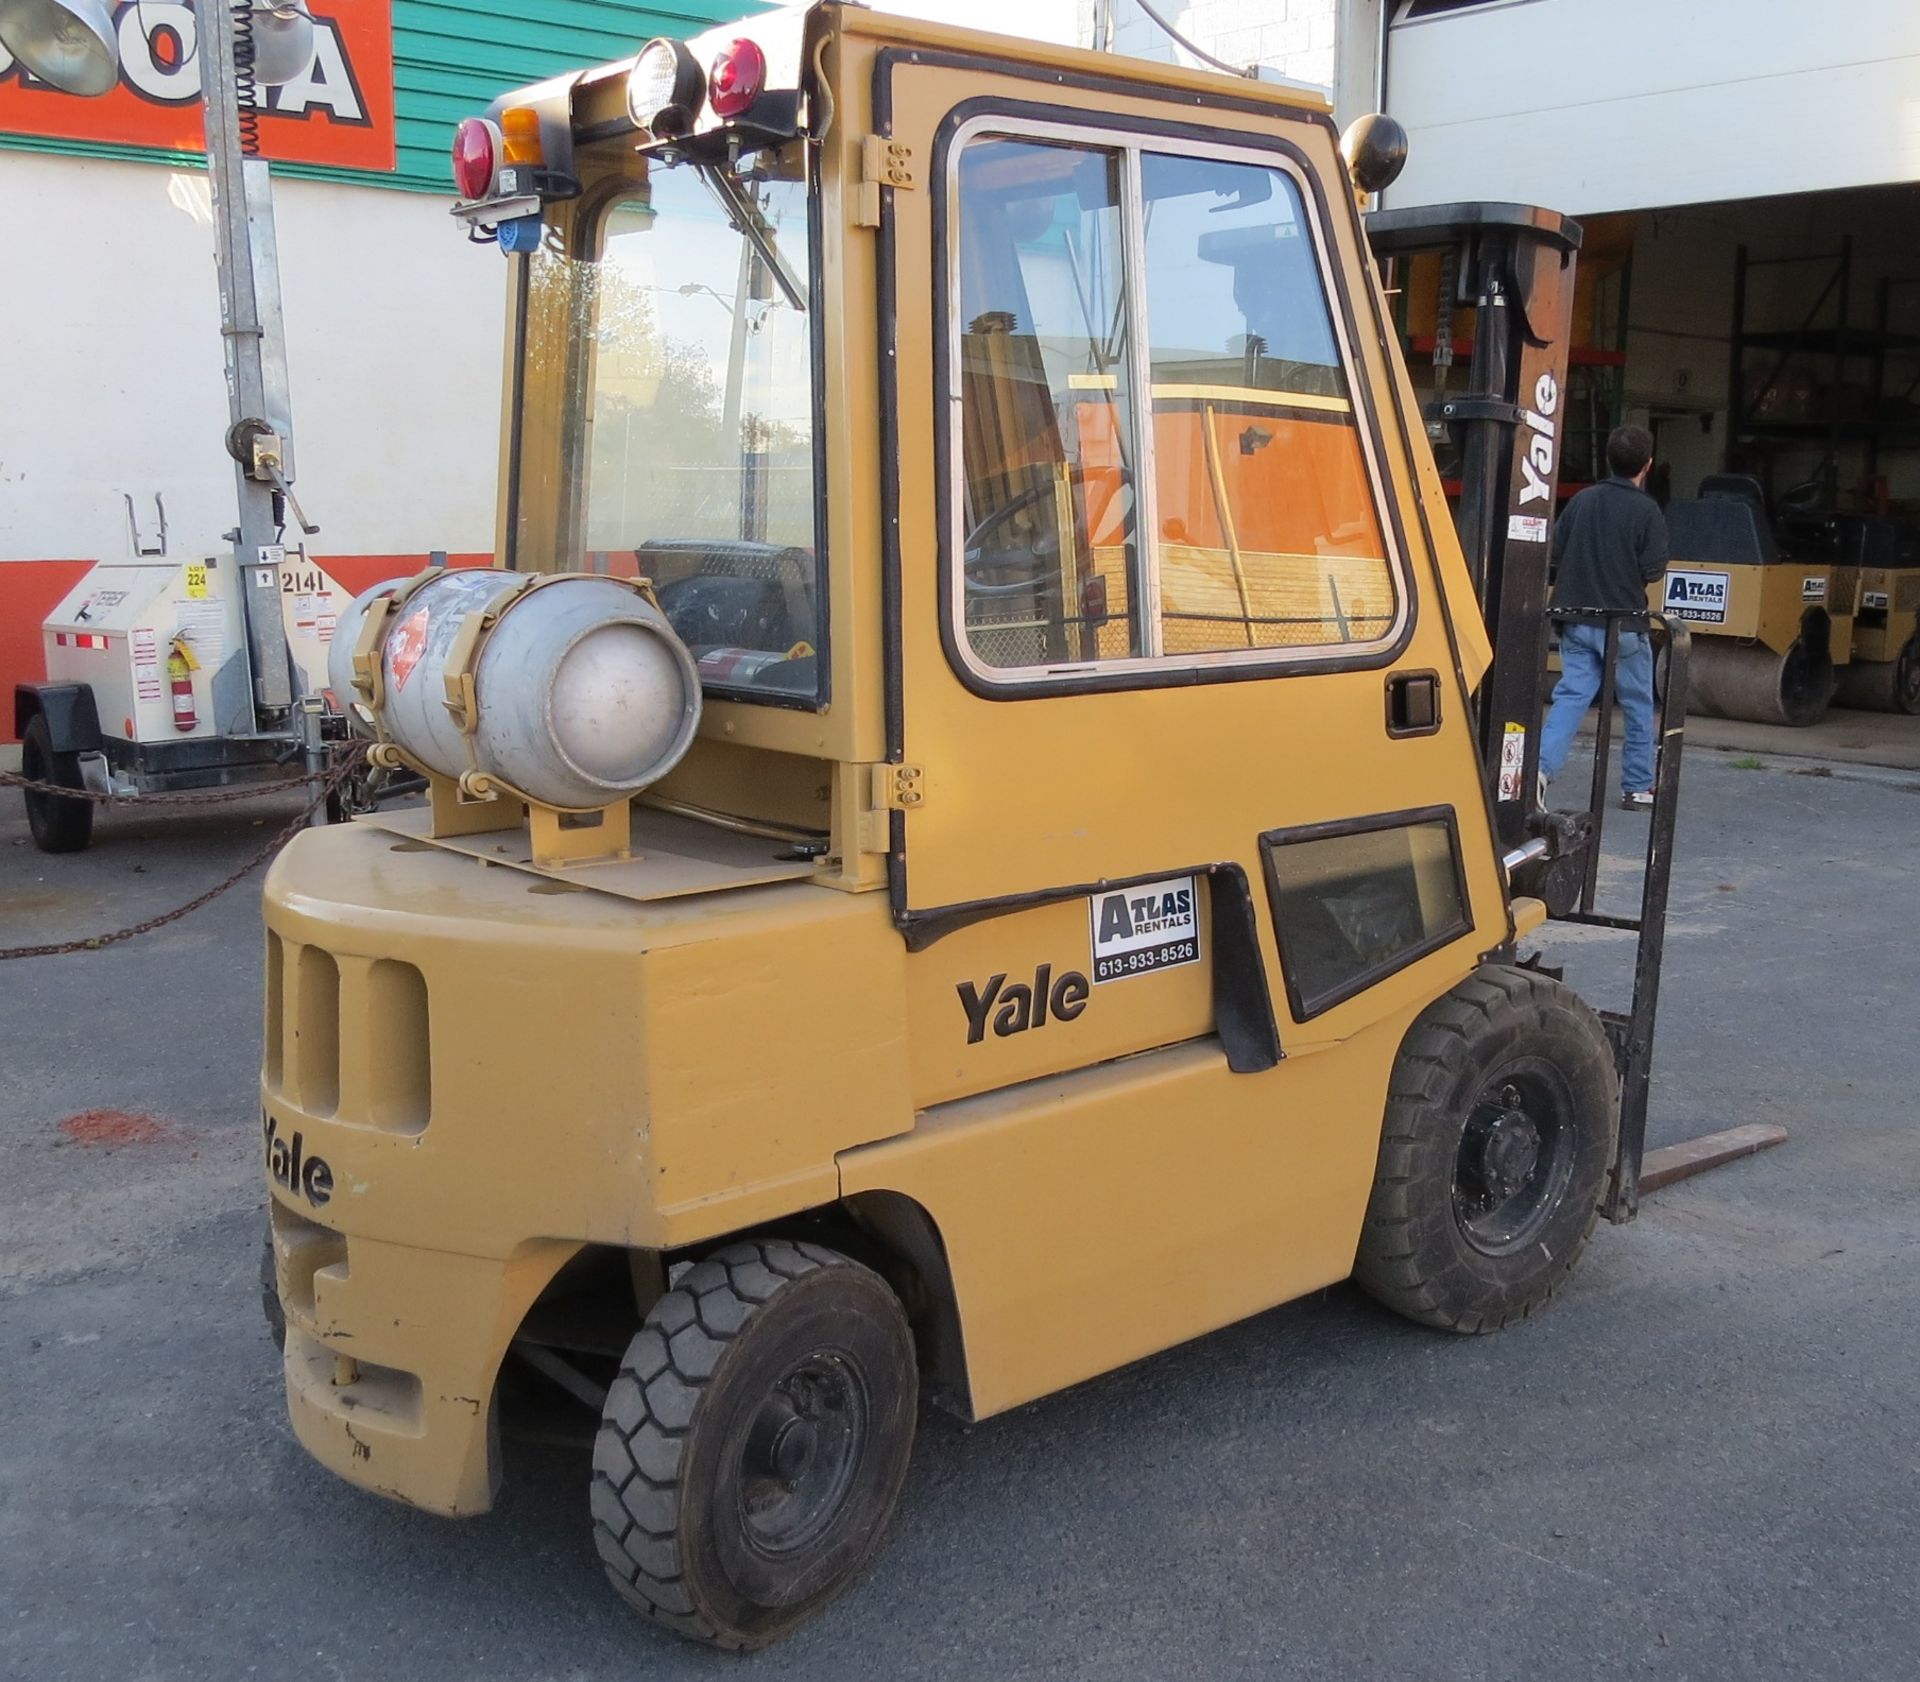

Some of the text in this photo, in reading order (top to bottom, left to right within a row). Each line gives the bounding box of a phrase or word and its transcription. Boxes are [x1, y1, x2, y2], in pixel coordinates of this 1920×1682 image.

[1519, 374, 1558, 506] Yale
[188, 573, 207, 586] 224
[282, 570, 324, 593] 2141
[1668, 577, 1724, 601] ATLAS
[1689, 595, 1723, 604] RENTALS
[1099, 889, 1191, 944] ATLAS
[1135, 914, 1191, 936] RENTALS
[1099, 943, 1194, 977] 613-933-8526
[956, 963, 1090, 1045] Yale
[262, 1104, 334, 1209] Yale
